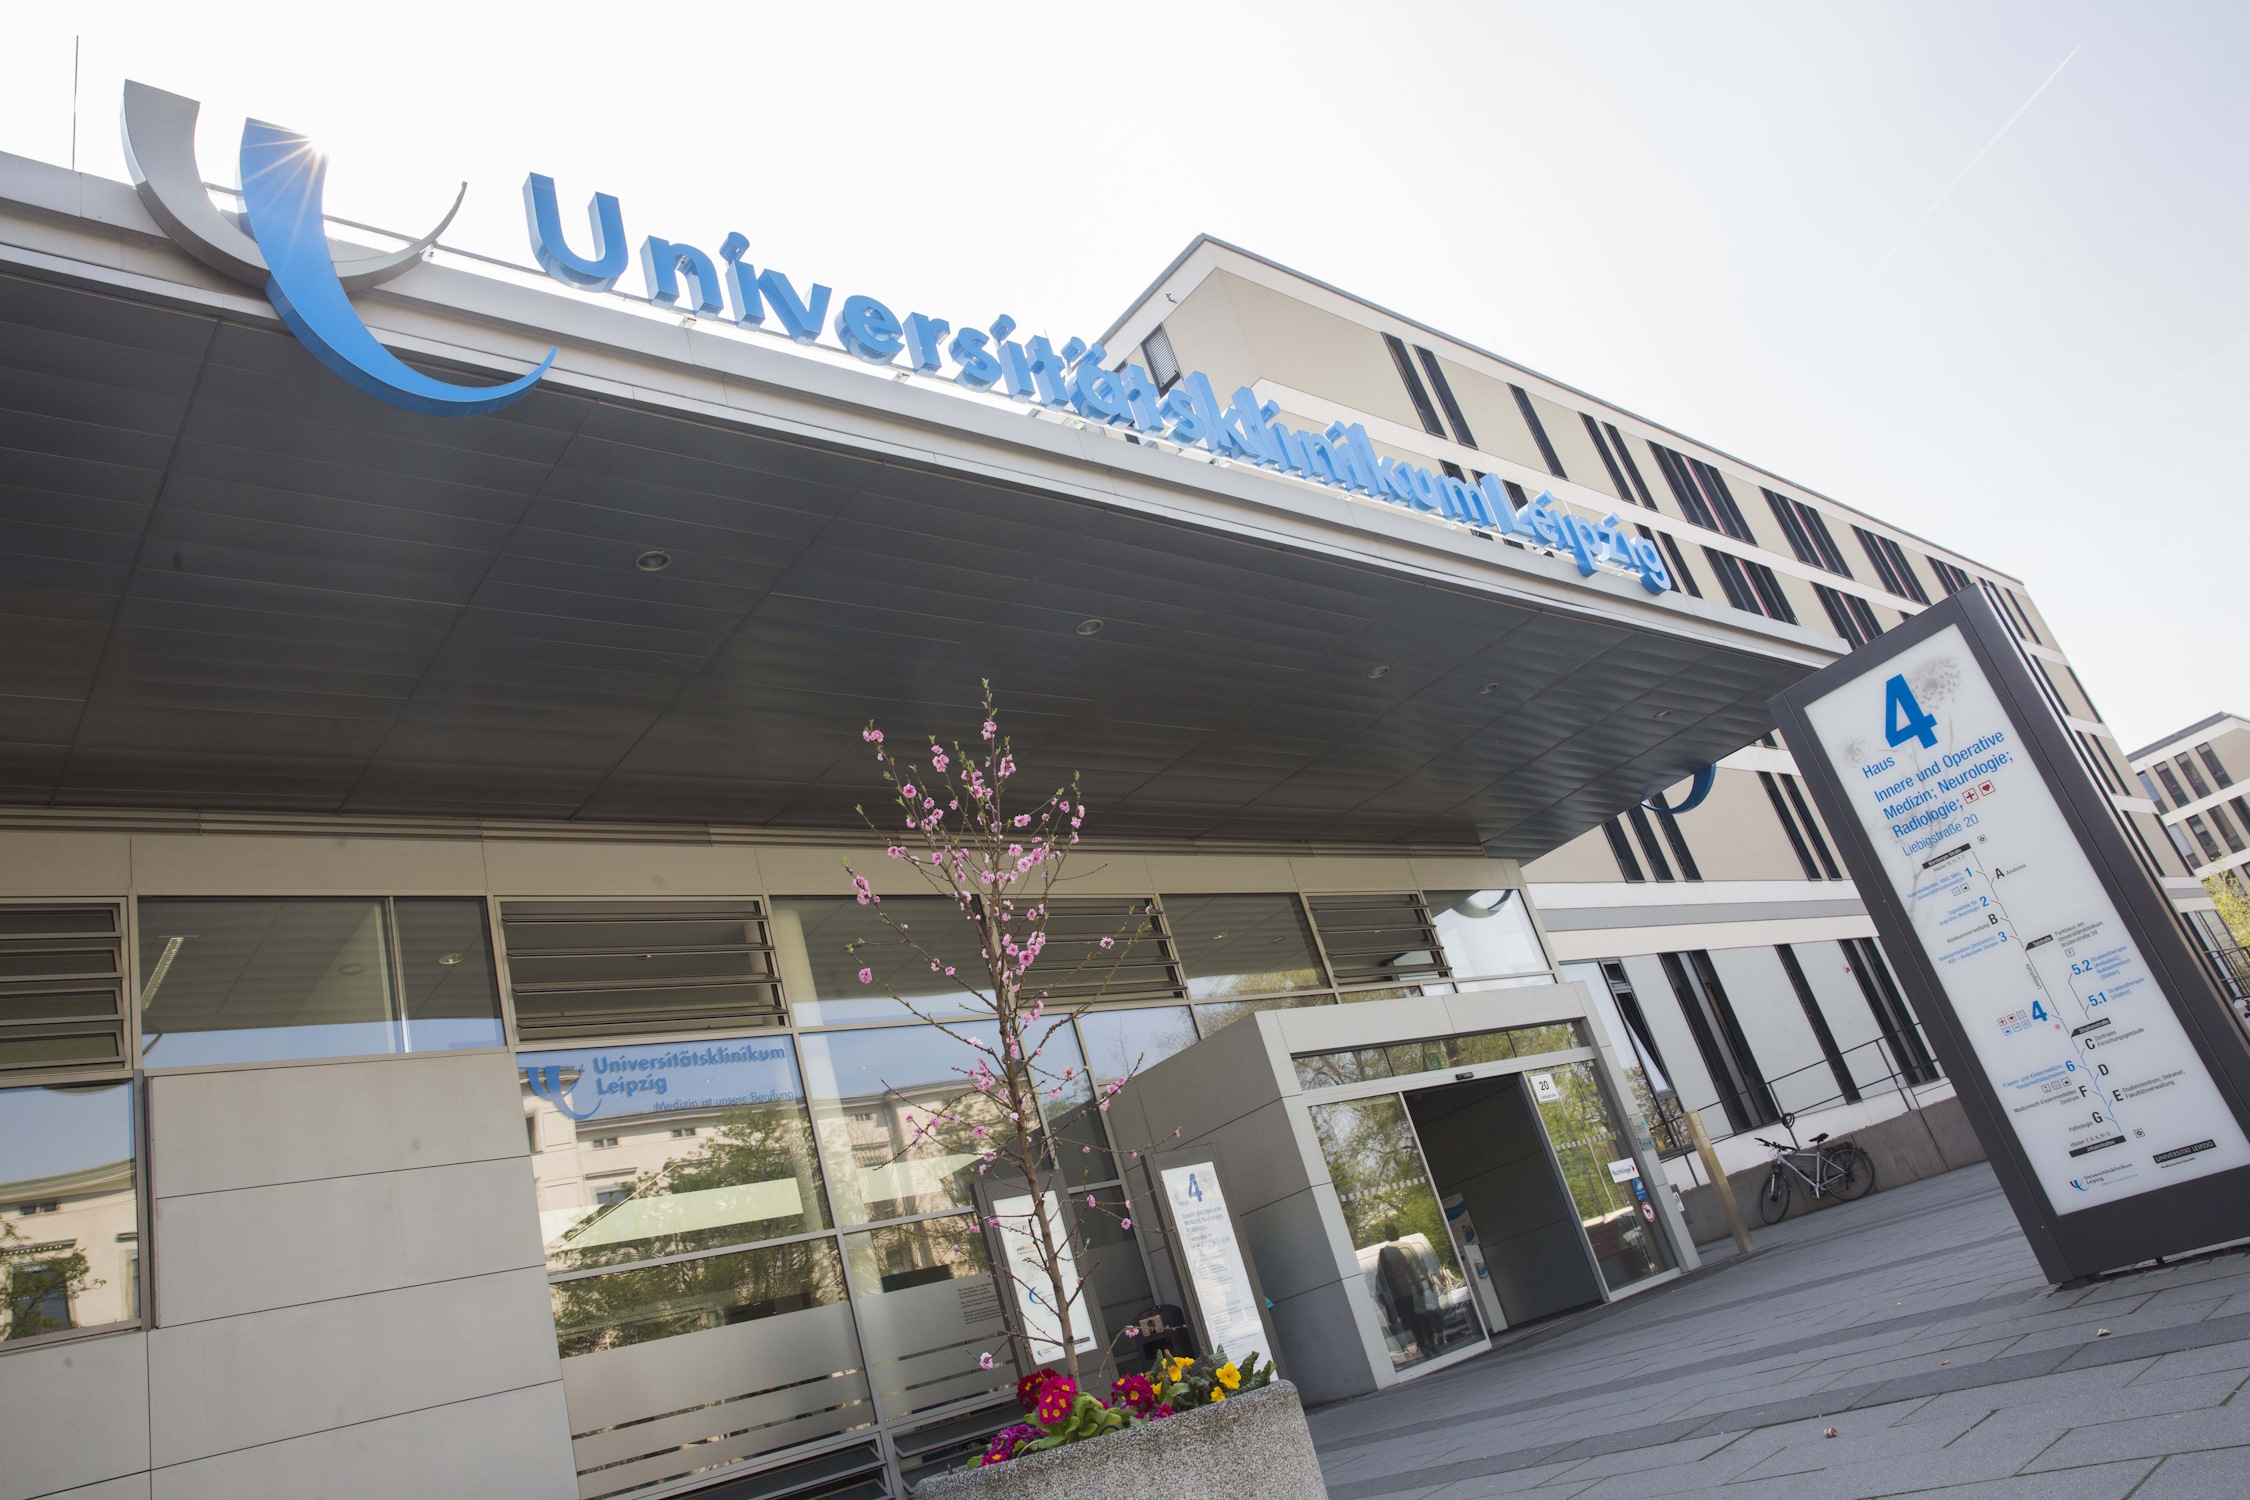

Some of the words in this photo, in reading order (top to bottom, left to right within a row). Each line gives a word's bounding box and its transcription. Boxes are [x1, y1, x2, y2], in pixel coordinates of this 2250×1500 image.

[522, 172, 1497, 530] Universitätsklinikum
[1479, 472, 1672, 596] Leipzig
[1885, 673, 1938, 749] 4
[1862, 757, 1895, 778] Haus
[1874, 777, 1914, 802] Innere
[1916, 762, 1941, 782] und
[1942, 731, 2005, 772] Operative
[1883, 788, 1938, 820] Medizin;
[1937, 751, 2014, 794] Neurologie;
[1892, 798, 1964, 838] Radiologie;
[1902, 822, 1963, 857] Liebigstraße
[1963, 813, 1979, 828] 20
[1965, 867, 1972, 877] 1
[1995, 868, 2005, 879] A
[2006, 863, 2026, 875] Anatomie
[1979, 896, 1989, 907] 2
[1988, 913, 1998, 924] B
[1946, 923, 1990, 943] Klinikumsverwaltung
[1998, 931, 2007, 942] 3
[2054, 925, 2076, 936] Parkhaus
[2060, 933, 2090, 947] Brüderstraße
[2071, 959, 2092, 975] 5.2
[2088, 991, 2106, 1006] 5.1
[2032, 1000, 2048, 1022] 4
[2094, 1030, 2116, 1041] Zentrales
[2097, 1028, 2144, 1046] Forschungsgebäude
[2084, 1038, 2095, 1049] C
[592, 1045, 785, 1074] Universitätsklinikum
[2064, 1059, 2076, 1072] 6
[2097, 1063, 2110, 1076] D
[596, 1074, 668, 1098] Leipzig
[1538, 1080, 1550, 1090] 20
[2078, 1085, 2087, 1097] F
[2125, 1080, 2175, 1098] Fakultätsverwaltung
[655, 1098, 698, 1112] Medizin
[700, 1096, 712, 1107] ist
[716, 1095, 748, 1106] unsere
[750, 1089, 794, 1104] Berufung
[2060, 1095, 2079, 1105] Zentrum
[2112, 1089, 2123, 1101] E
[2092, 1111, 2103, 1123] G
[2068, 1121, 2093, 1132] Pathologie
[2191, 1141, 2213, 1151] LEIPZIG
[1188, 1173, 1202, 1202] 4
